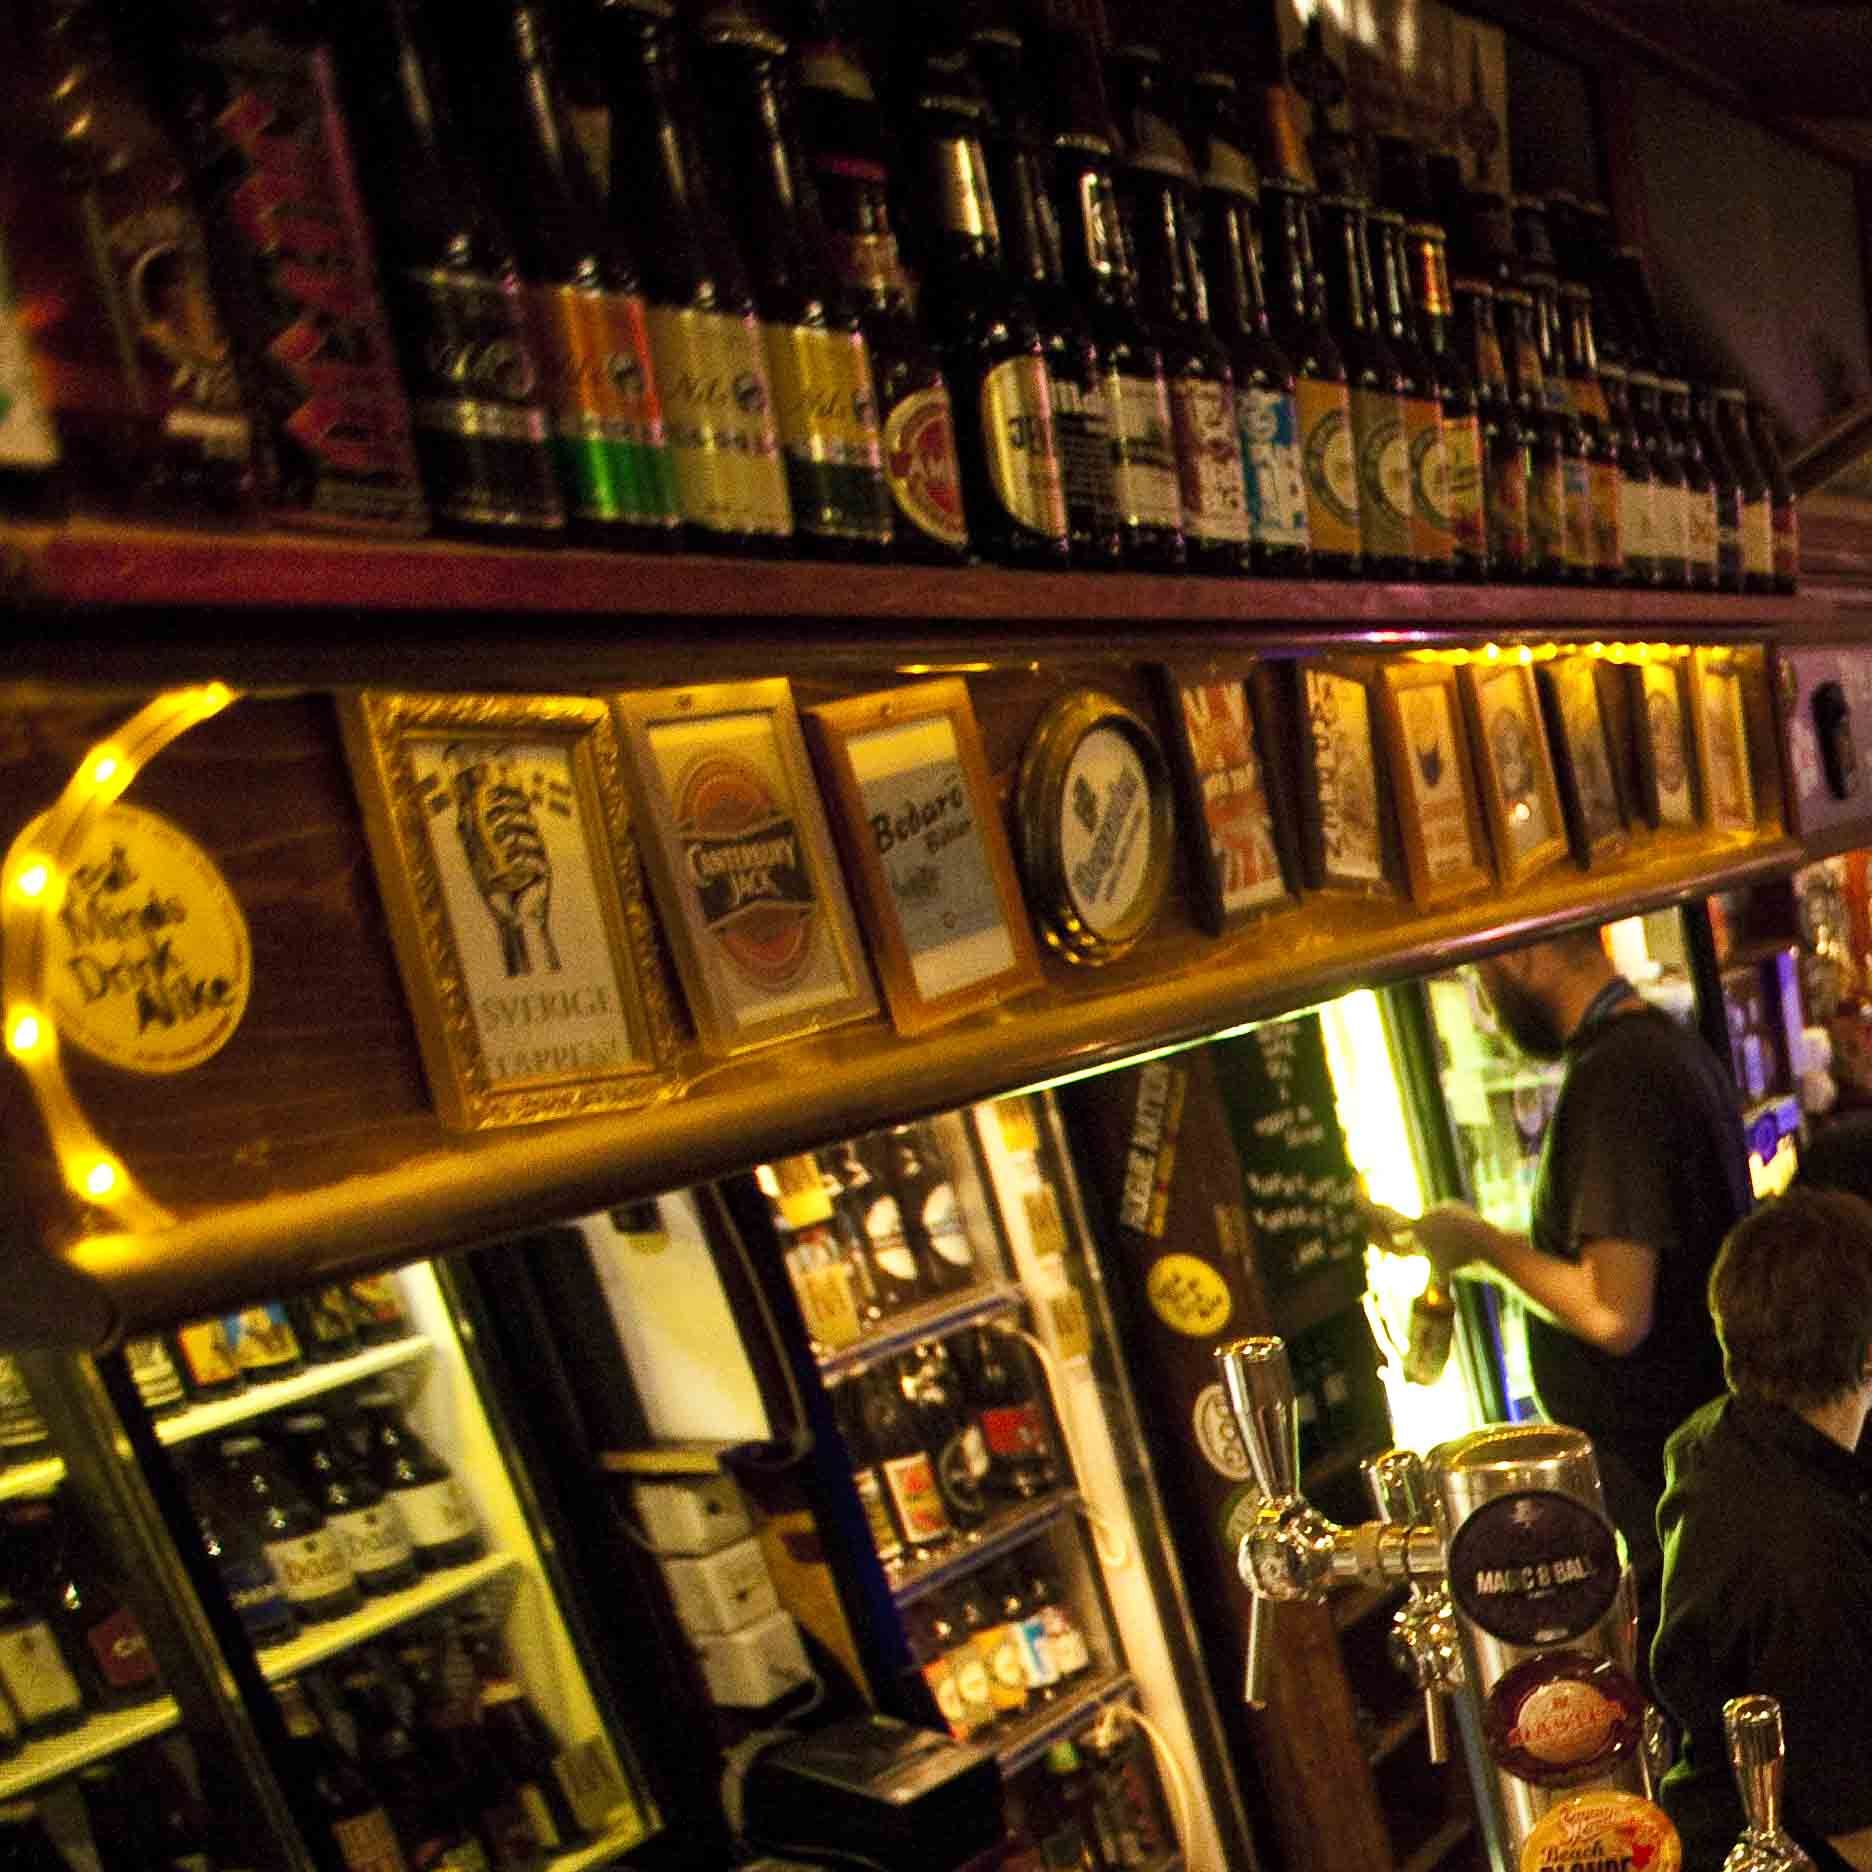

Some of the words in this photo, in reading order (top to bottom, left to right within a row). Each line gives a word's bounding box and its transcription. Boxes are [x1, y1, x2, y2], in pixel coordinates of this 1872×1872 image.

[68, 939, 178, 1006] Drink
[136, 974, 236, 1034] Alike
[480, 984, 616, 1034] SVERIGE
